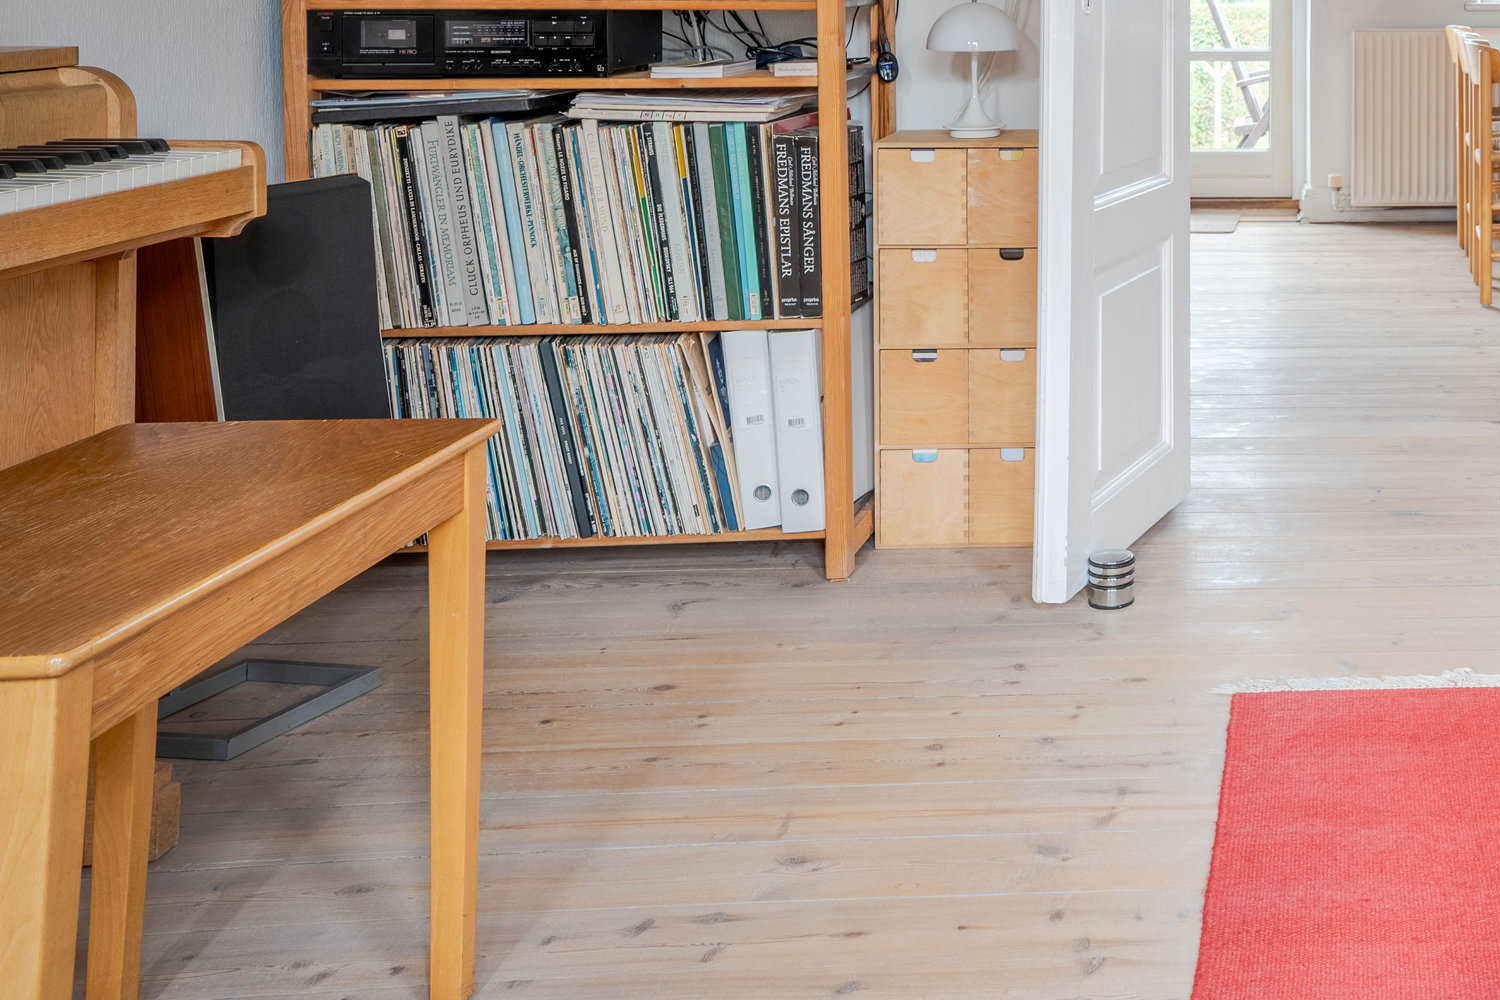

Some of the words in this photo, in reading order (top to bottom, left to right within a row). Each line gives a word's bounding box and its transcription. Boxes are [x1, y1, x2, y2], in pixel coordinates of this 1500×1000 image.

[445, 121, 460, 174] EURYDIKE
[559, 158, 567, 175] NOZZE
[403, 158, 411, 184] DONIZETTI
[452, 178, 463, 201] UND
[562, 182, 570, 200] FIGARO
[776, 144, 789, 214] FREDMANS
[801, 147, 812, 218] FREDMANS
[439, 214, 447, 225] IN
[657, 213, 666, 240] FLEDERMAUS
[440, 228, 456, 286] MEMORIAM
[779, 218, 792, 278] EPISTLAR
[803, 221, 815, 274] SÅNGER
